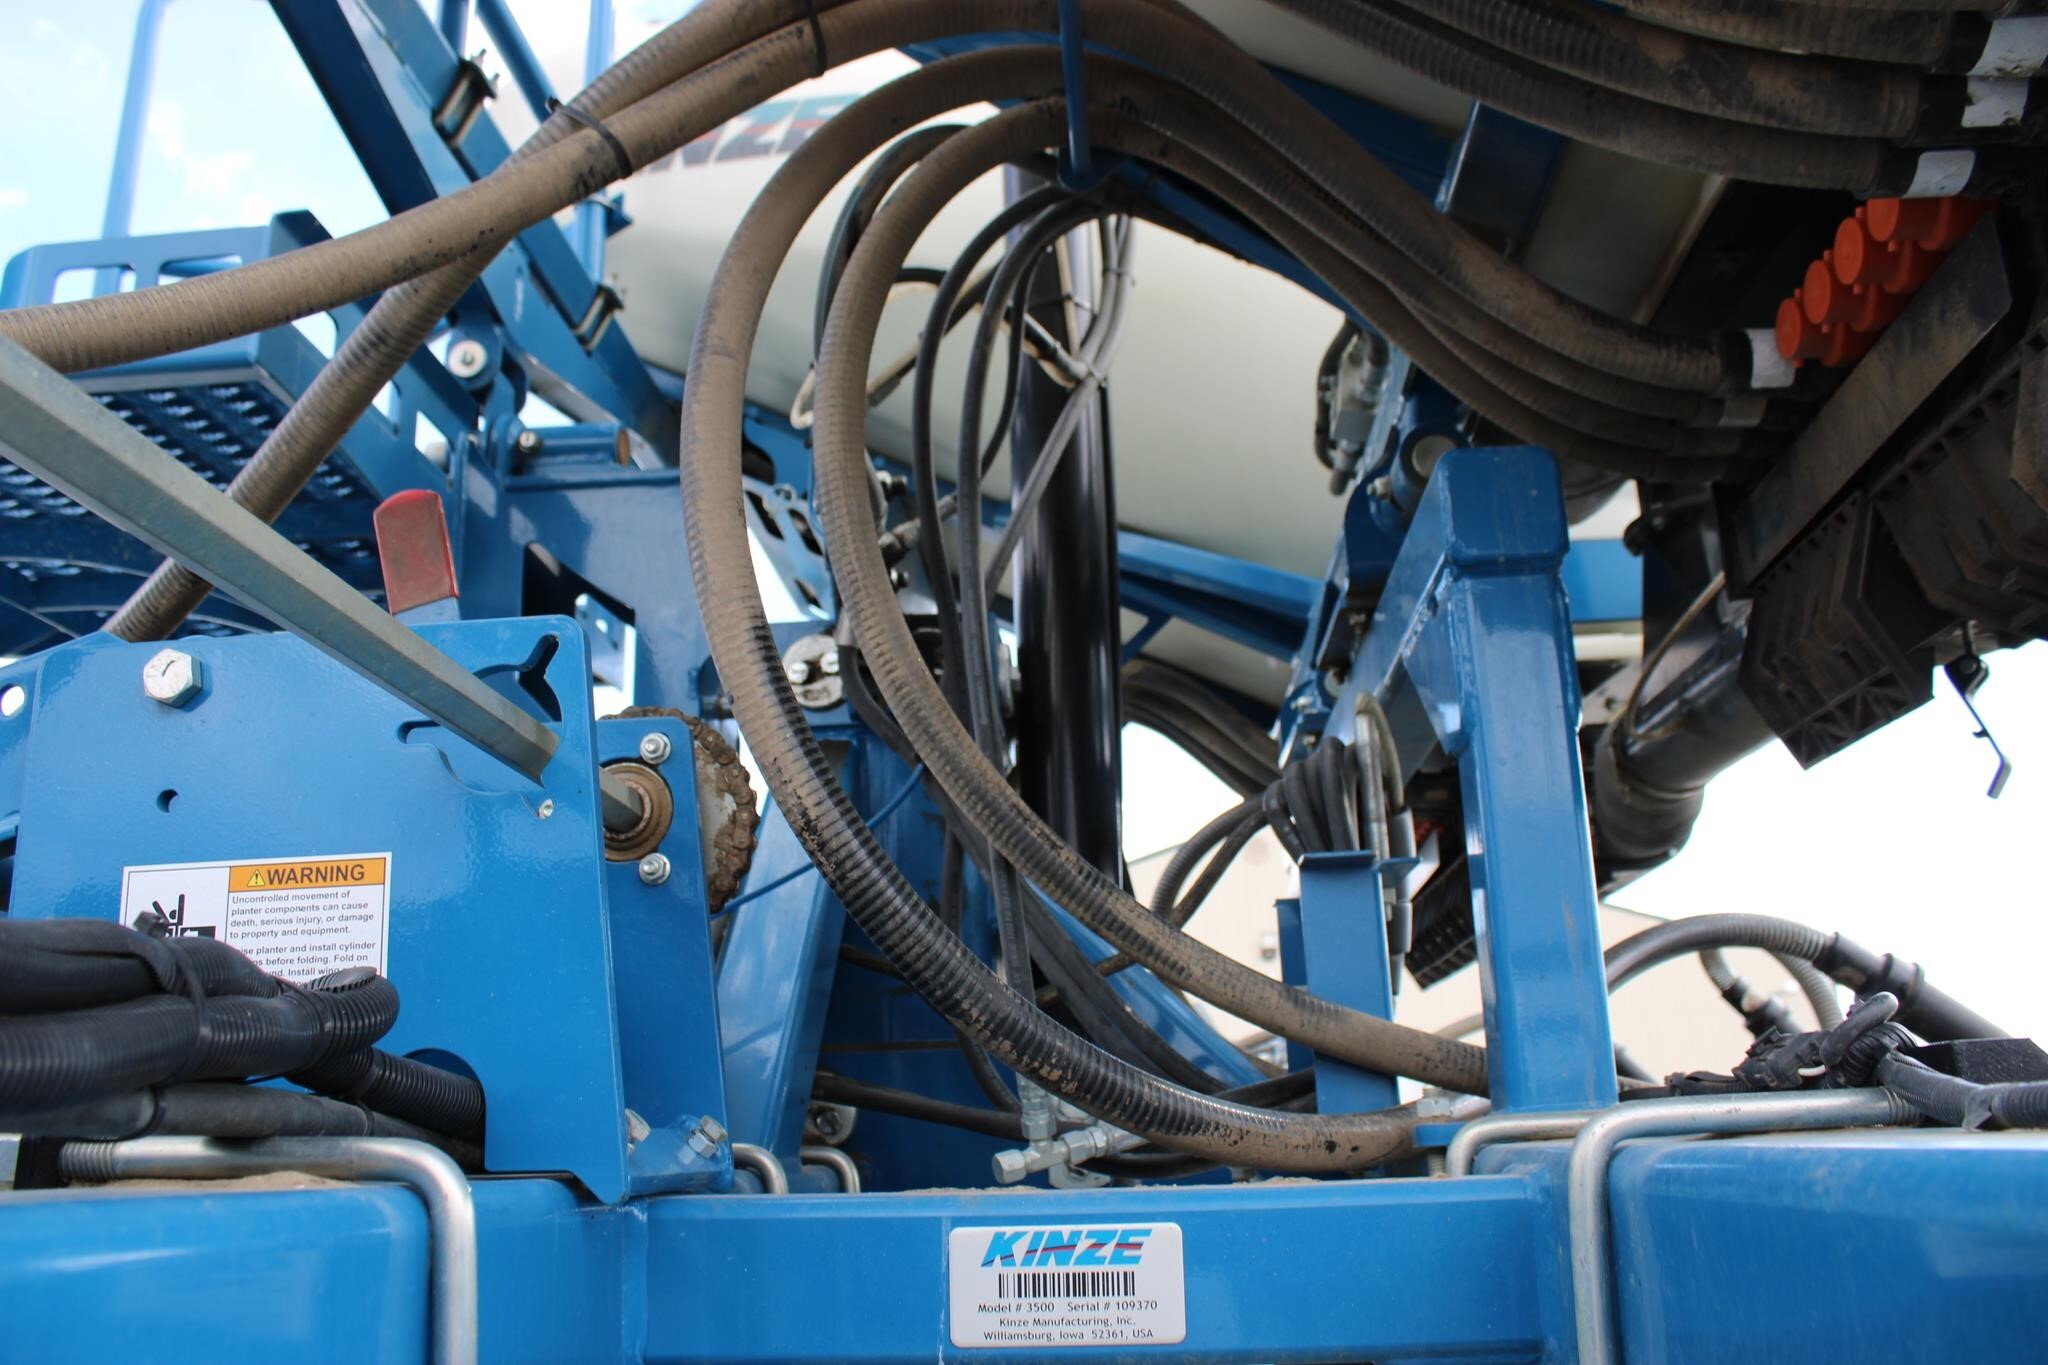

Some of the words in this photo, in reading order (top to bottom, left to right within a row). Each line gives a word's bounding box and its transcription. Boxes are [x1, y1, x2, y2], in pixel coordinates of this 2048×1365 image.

[267, 864, 365, 885] WARNING
[232, 894, 289, 904] Uncontrolled
[292, 892, 338, 901] movement
[341, 890, 350, 898] of
[231, 907, 262, 916] planter
[264, 903, 320, 914] components
[323, 902, 338, 910] can
[341, 901, 368, 909] cause
[231, 917, 257, 928] death,
[260, 915, 293, 925] serious
[297, 914, 323, 925] injury,
[338, 912, 374, 923] damage
[230, 929, 239, 938] to
[242, 929, 279, 940] property
[281, 927, 298, 936] and
[301, 926, 351, 937] equipment.
[256, 945, 287, 956] planter
[290, 944, 306, 952] and
[309, 943, 336, 951] install
[339, 941, 376, 951] cylinder
[266, 956, 294, 965] before
[297, 956, 330, 966] folding.
[334, 954, 354, 962] Fold
[288, 967, 315, 976] Install
[981, 1229, 1152, 1267] KINZE
[978, 1304, 1011, 1313] Model
[1016, 1304, 1022, 1312] #
[1027, 1303, 1055, 1312] 3500
[1067, 1302, 1099, 1311] Serial
[1104, 1302, 1110, 1310] #
[1116, 1301, 1157, 1310] 109370
[1000, 1318, 1028, 1327] Kinze
[1033, 1317, 1112, 1328] Manufacturing,
[1117, 1317, 1136, 1326] Inc.
[984, 1331, 1055, 1342] Williamsburg,
[1060, 1331, 1083, 1340] Iowa
[1092, 1330, 1128, 1340] 52361,
[1133, 1329, 1153, 1338] USA
